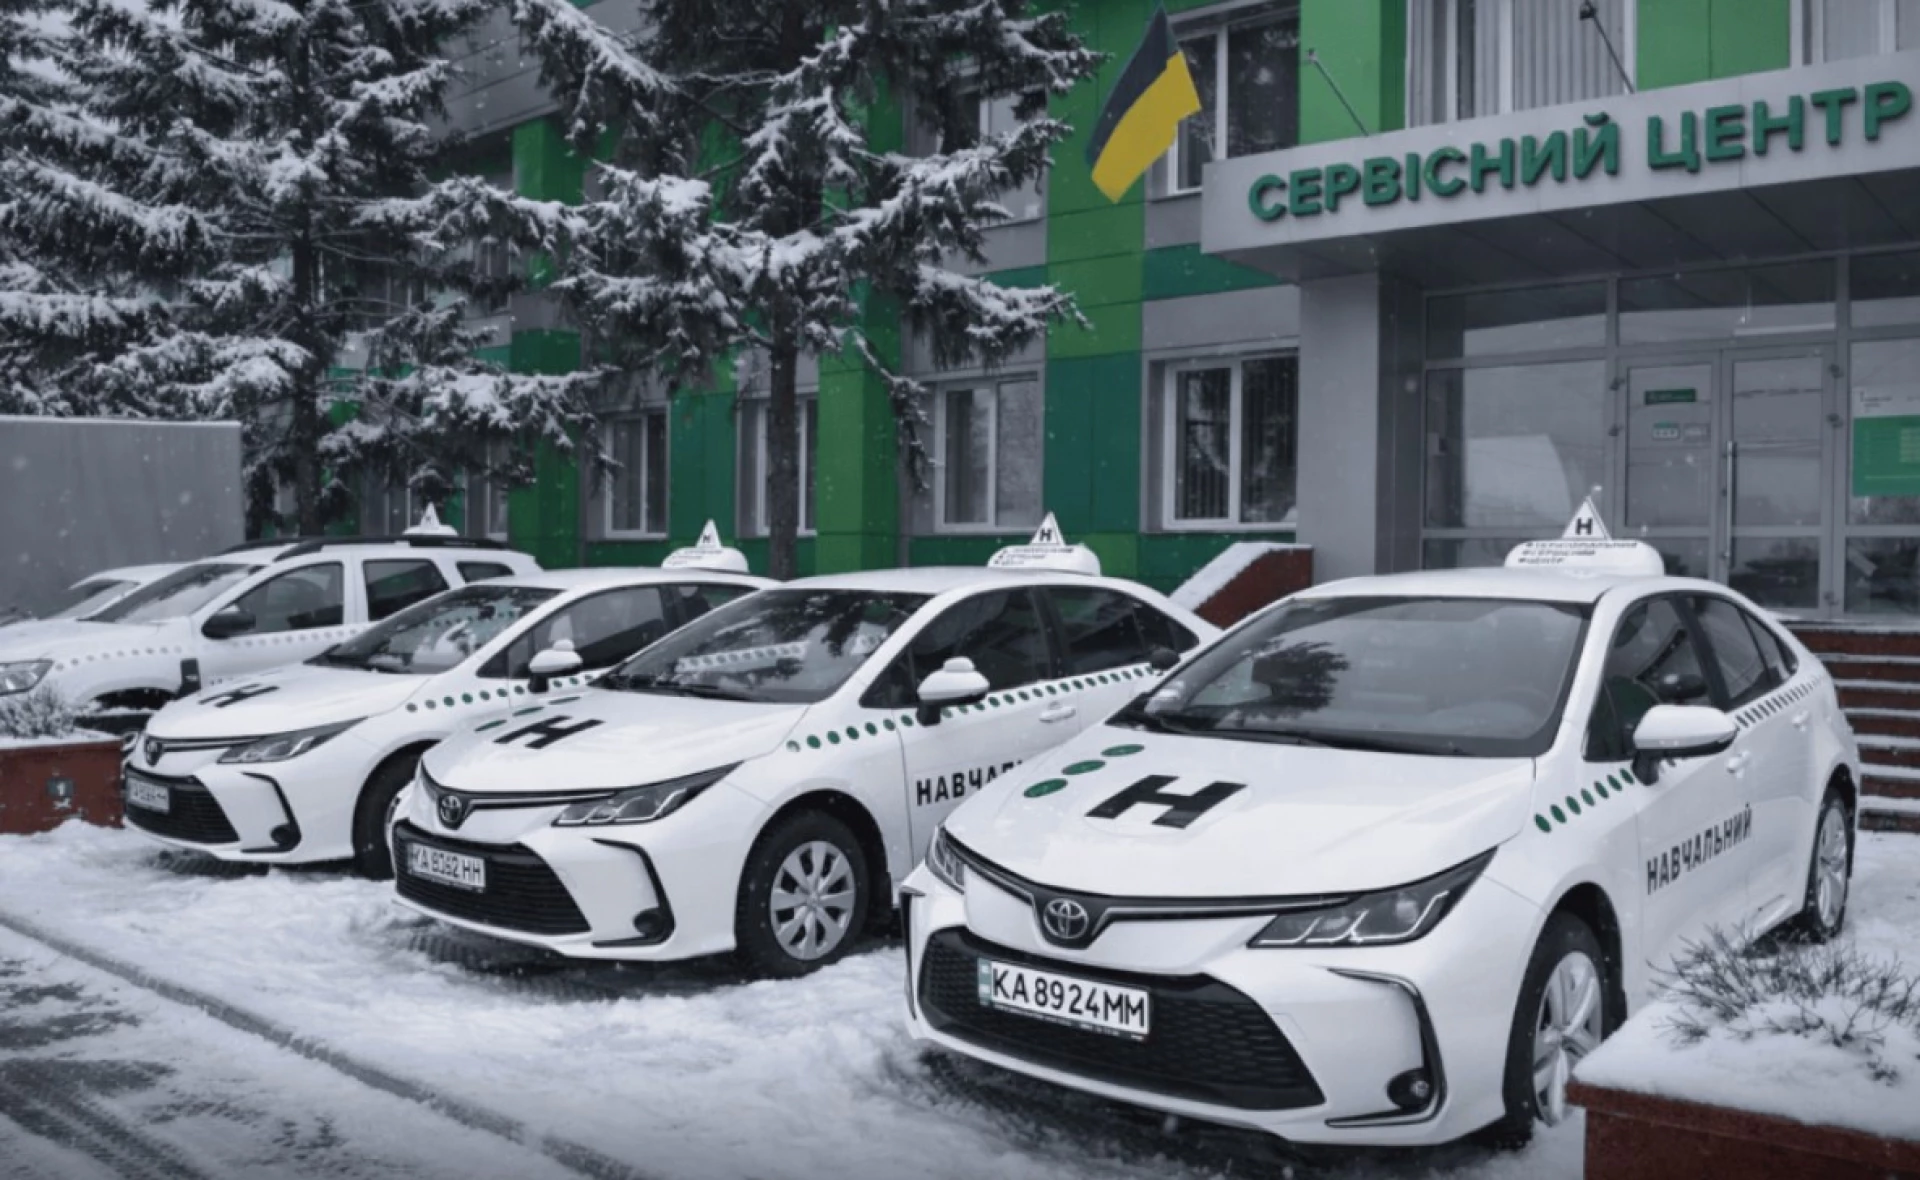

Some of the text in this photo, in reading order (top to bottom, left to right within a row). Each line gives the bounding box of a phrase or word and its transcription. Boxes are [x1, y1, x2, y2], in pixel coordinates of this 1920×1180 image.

[1248, 80, 1912, 222] СЕРВІСНИЙ ЦЕНТР
[1575, 517, 1594, 536] Н
[492, 715, 606, 749] Н
[1084, 774, 1249, 829] Н
[1646, 800, 1752, 895] НАВЧАЛЬНИЙ
